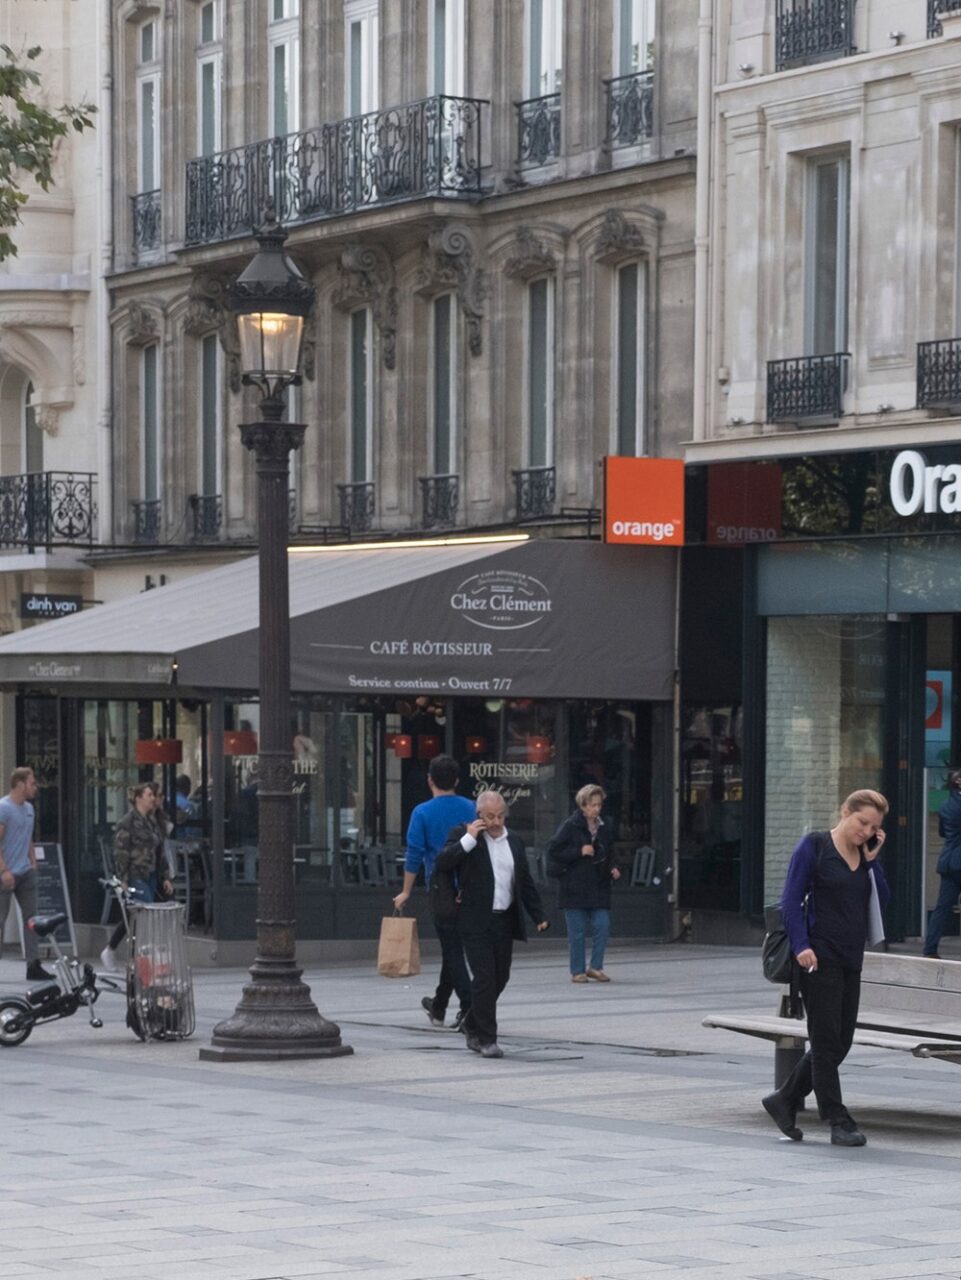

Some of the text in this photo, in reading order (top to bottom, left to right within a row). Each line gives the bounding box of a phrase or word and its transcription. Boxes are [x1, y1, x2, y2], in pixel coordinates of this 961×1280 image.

[611, 520, 675, 541] orange
[26, 596, 77, 611] dinh van
[450, 593, 552, 612] Chez Clément
[369, 639, 493, 656] CAFÉ RÔTISSEUR
[347, 674, 512, 690] Service continu Ouvert 7/7
[469, 761, 540, 780] RÔTISSERIE
